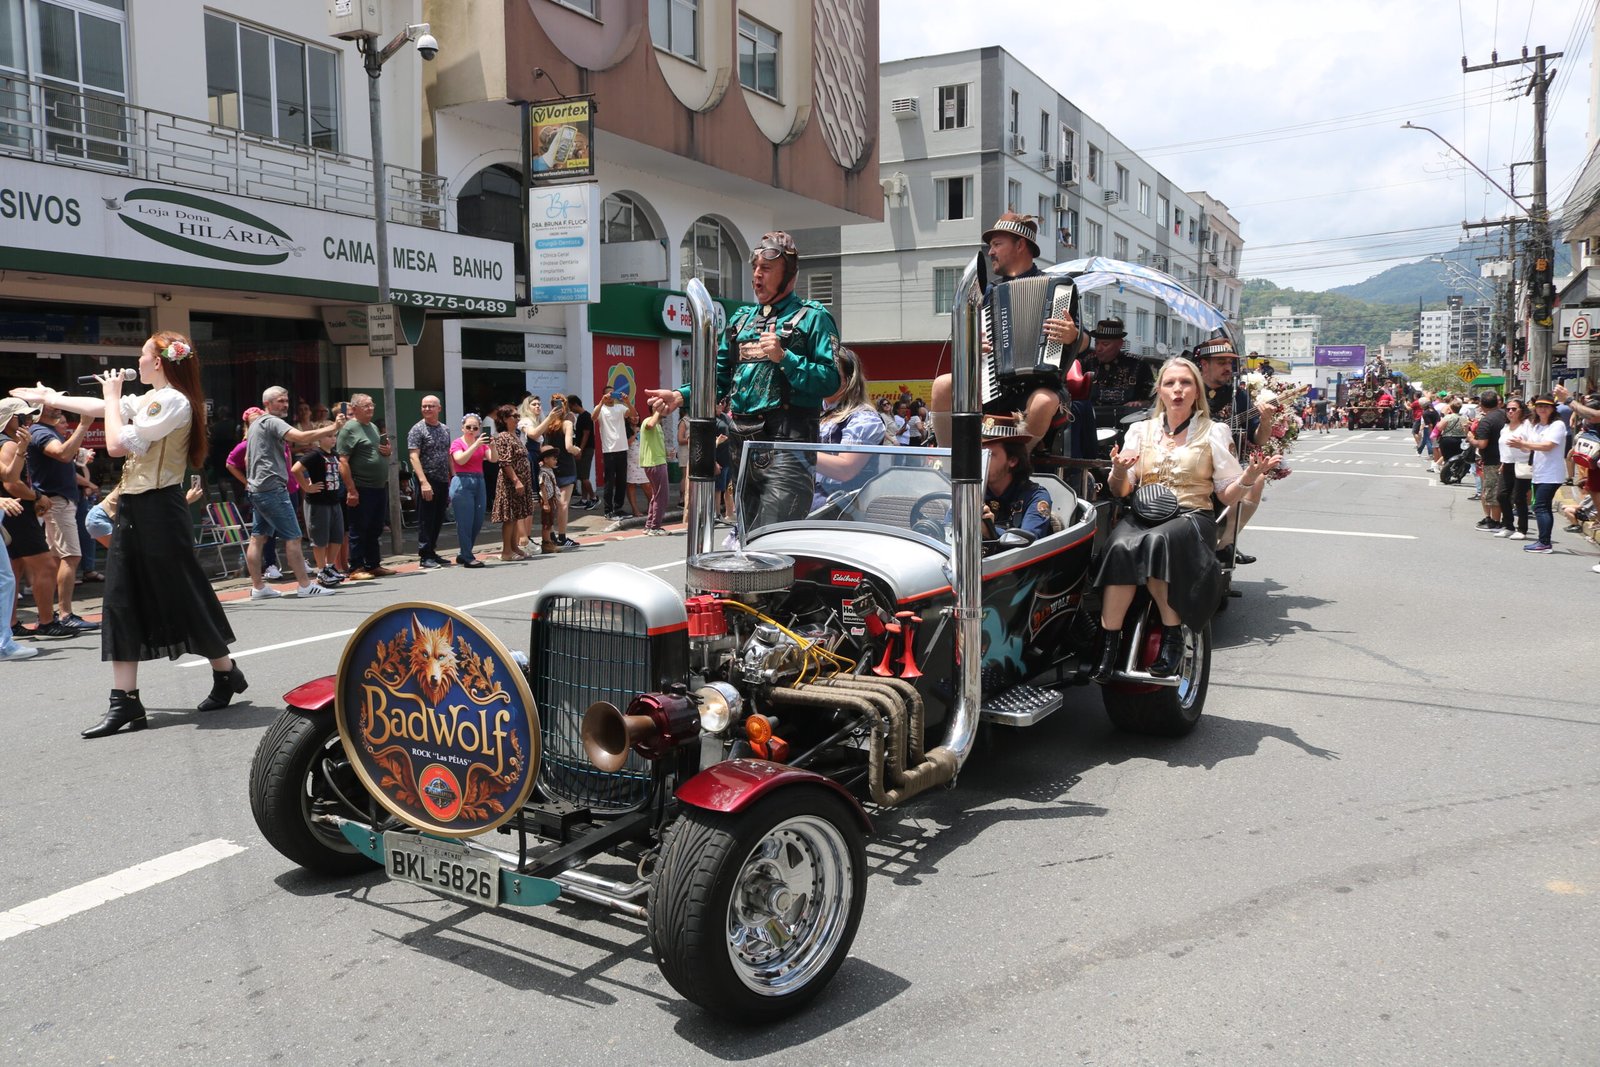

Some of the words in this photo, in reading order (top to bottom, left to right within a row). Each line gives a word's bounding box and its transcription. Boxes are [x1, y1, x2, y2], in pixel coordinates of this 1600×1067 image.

[545, 105, 588, 119] Vortex
[0, 189, 81, 227] SIVOS
[138, 204, 170, 219] Loja
[175, 210, 210, 223] Dona
[544, 220, 562, 228] BRUNA
[178, 220, 281, 249] HILÁRIA
[322, 236, 376, 265] CAMA
[393, 247, 438, 274] MESA
[453, 256, 503, 282] BANHO
[411, 293, 507, 314] 3275-0489
[1577, 321, 1584, 335] E
[606, 344, 622, 357] AQUI
[622, 345, 635, 357] TEM
[412, 748, 432, 759] ROCK
